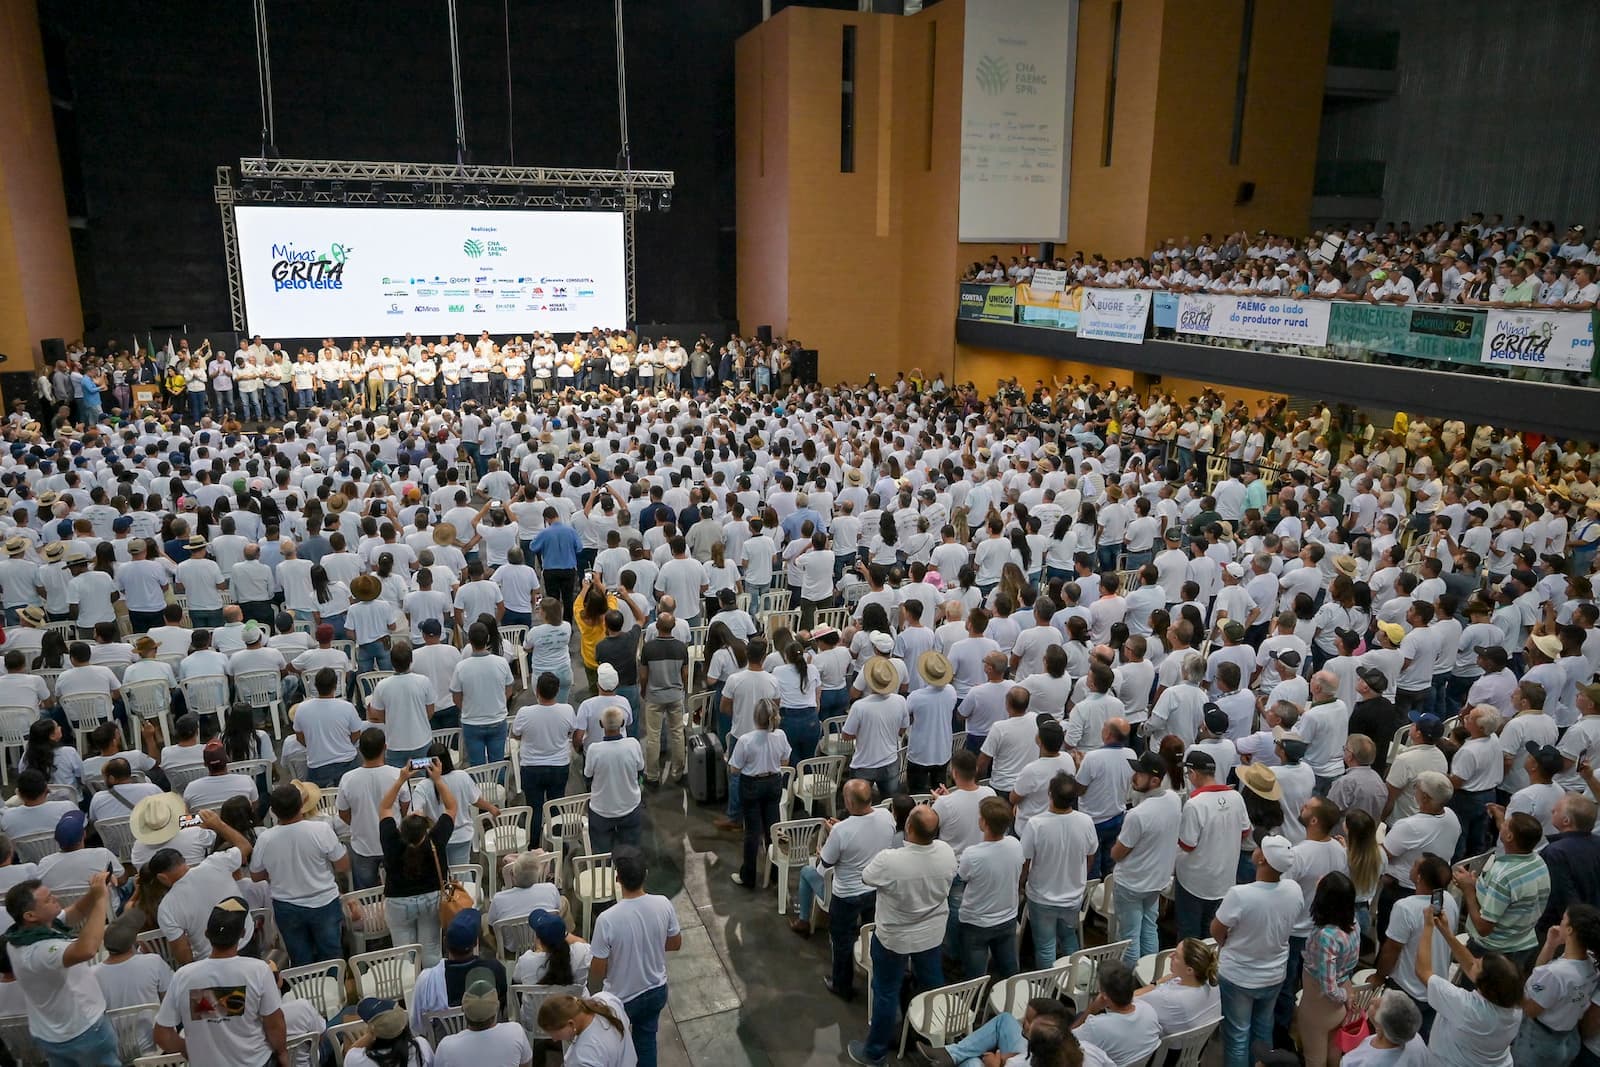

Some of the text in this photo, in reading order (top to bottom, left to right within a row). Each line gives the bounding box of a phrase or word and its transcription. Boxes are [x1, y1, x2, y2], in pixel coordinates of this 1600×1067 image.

[272, 242, 316, 263] Minas
[272, 260, 344, 281] GRITA
[274, 276, 343, 292] pelo leite
[962, 293, 984, 302] CONTRA
[989, 295, 1014, 305] UNIDOS
[1097, 301, 1125, 311] BUGRE
[1236, 301, 1304, 314] FAEMG ao lado
[1181, 311, 1212, 326] GRITA
[1230, 312, 1308, 328] do produtor rural
[1333, 306, 1342, 321] A
[1343, 307, 1408, 328] SEMENTES
[1496, 320, 1530, 336] Minas
[1490, 333, 1552, 354] GRITA
[1490, 348, 1545, 361] pelo leite
